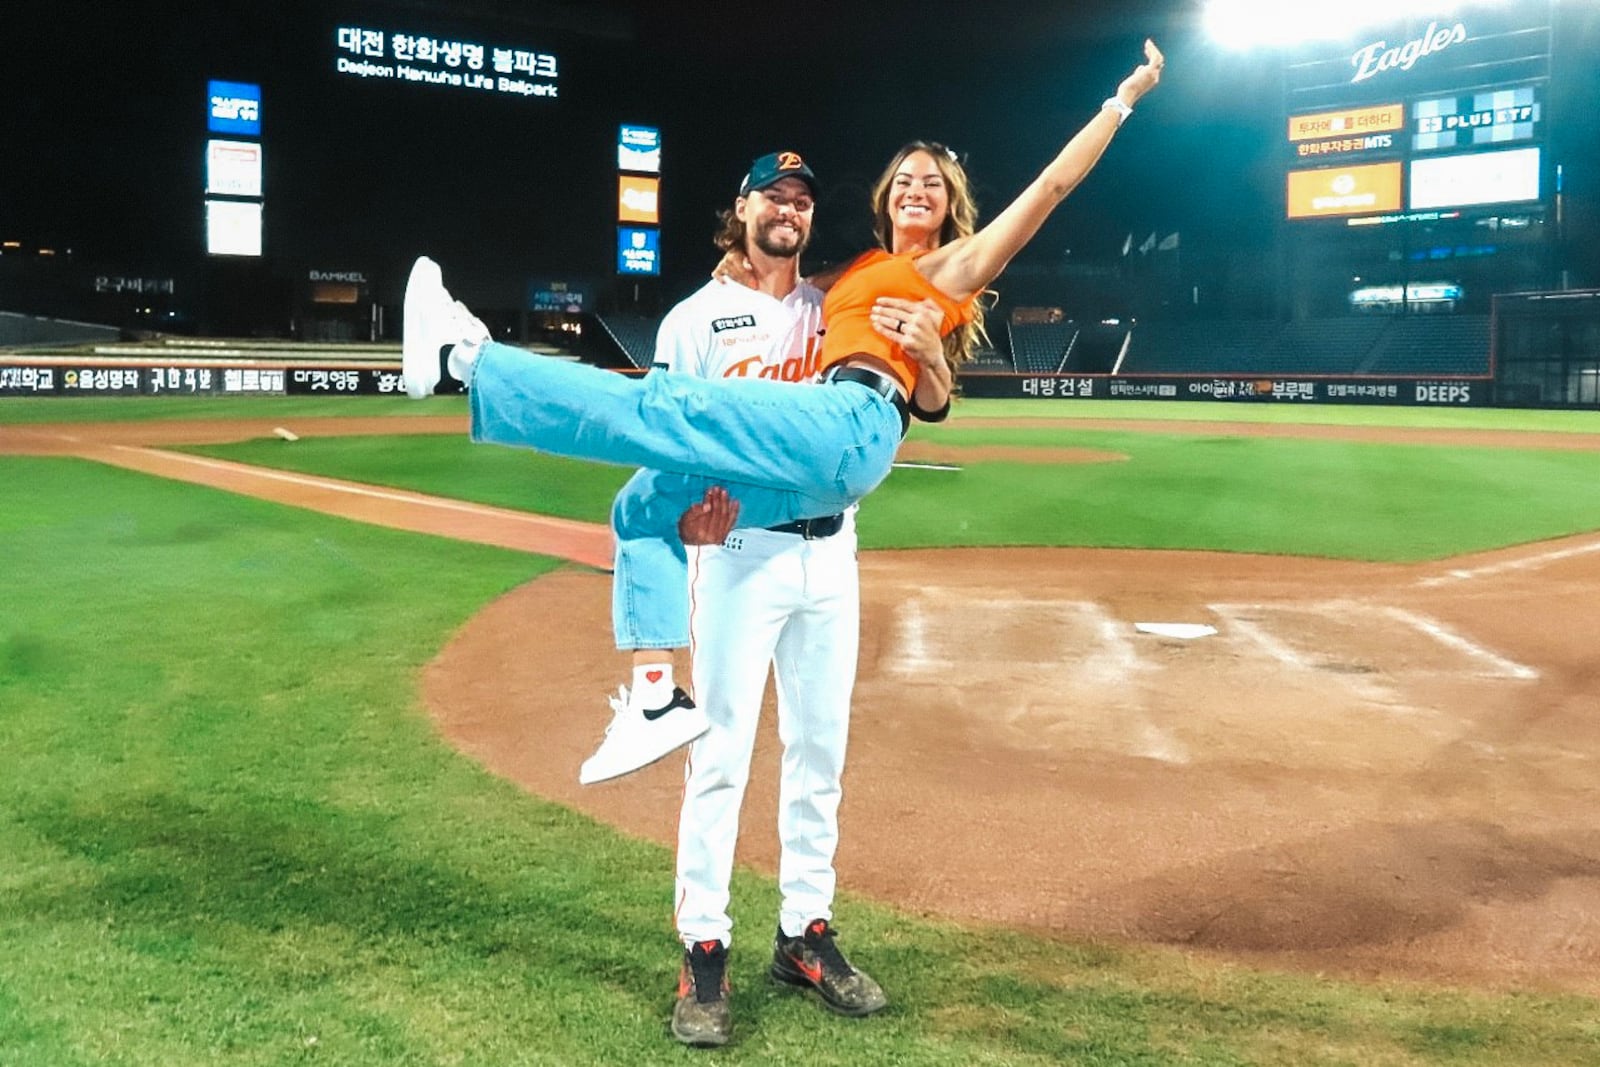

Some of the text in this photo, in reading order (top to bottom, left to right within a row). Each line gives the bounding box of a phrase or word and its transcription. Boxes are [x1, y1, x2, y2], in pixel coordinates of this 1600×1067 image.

[338, 27, 558, 77] 대전 한화생명 볼파크
[1351, 22, 1467, 83] Eagles
[336, 58, 558, 98] Daejeon Hanwha Life Ballpark
[1357, 113, 1391, 127] 더하다
[1446, 107, 1532, 128] PLUS ETF
[79, 369, 139, 389] 음성명작
[294, 370, 360, 390] 마켓영동
[1022, 378, 1093, 397] 대방건설
[1272, 381, 1314, 400] 부루펜
[1416, 385, 1470, 402] DEEPS
